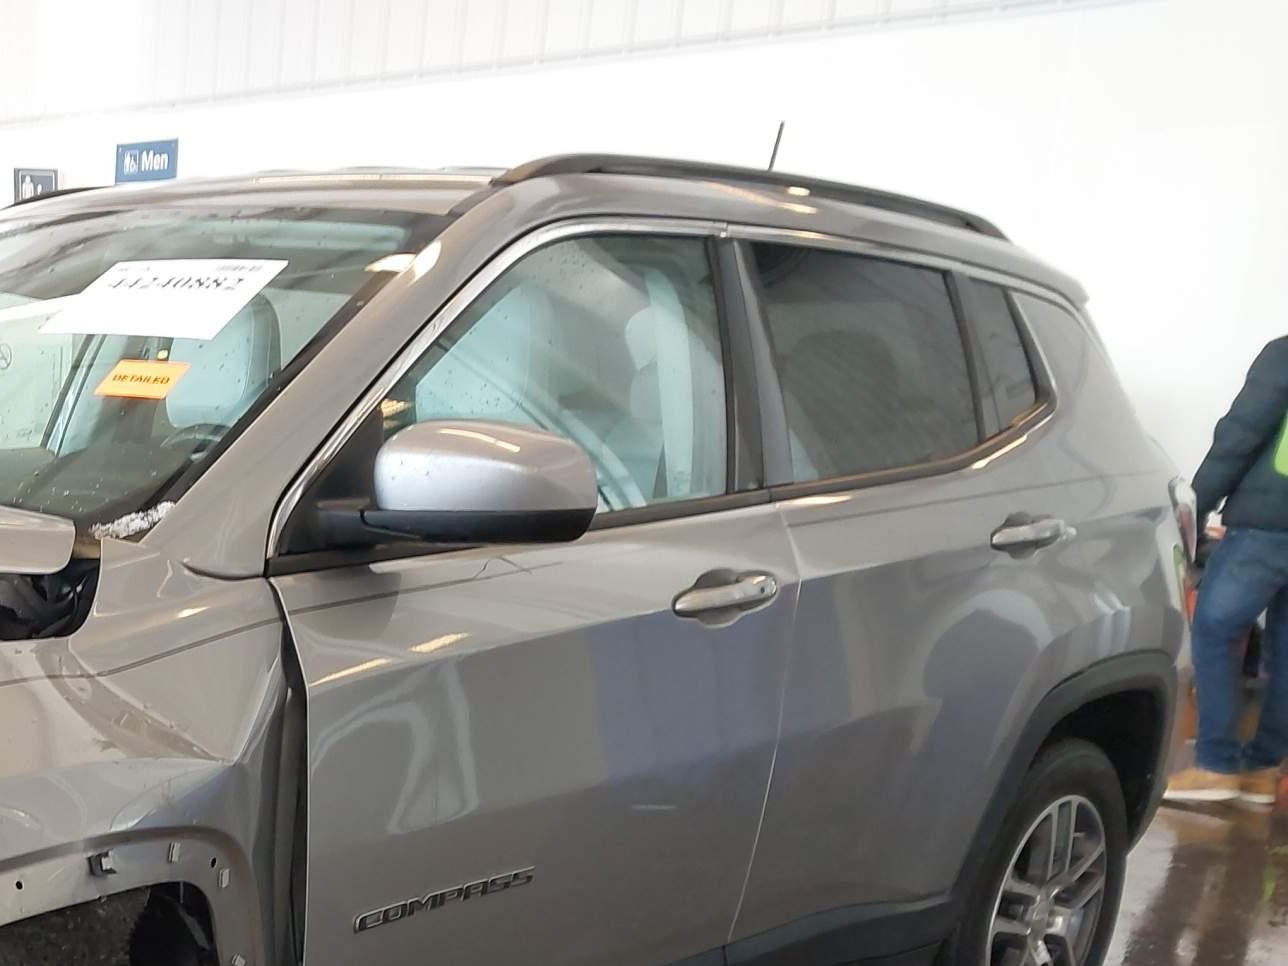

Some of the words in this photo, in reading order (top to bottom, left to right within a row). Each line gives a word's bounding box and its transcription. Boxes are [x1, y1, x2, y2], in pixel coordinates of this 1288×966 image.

[141, 149, 169, 171] Men
[112, 373, 171, 385] DETAILED
[353, 865, 536, 934] COMPASS
